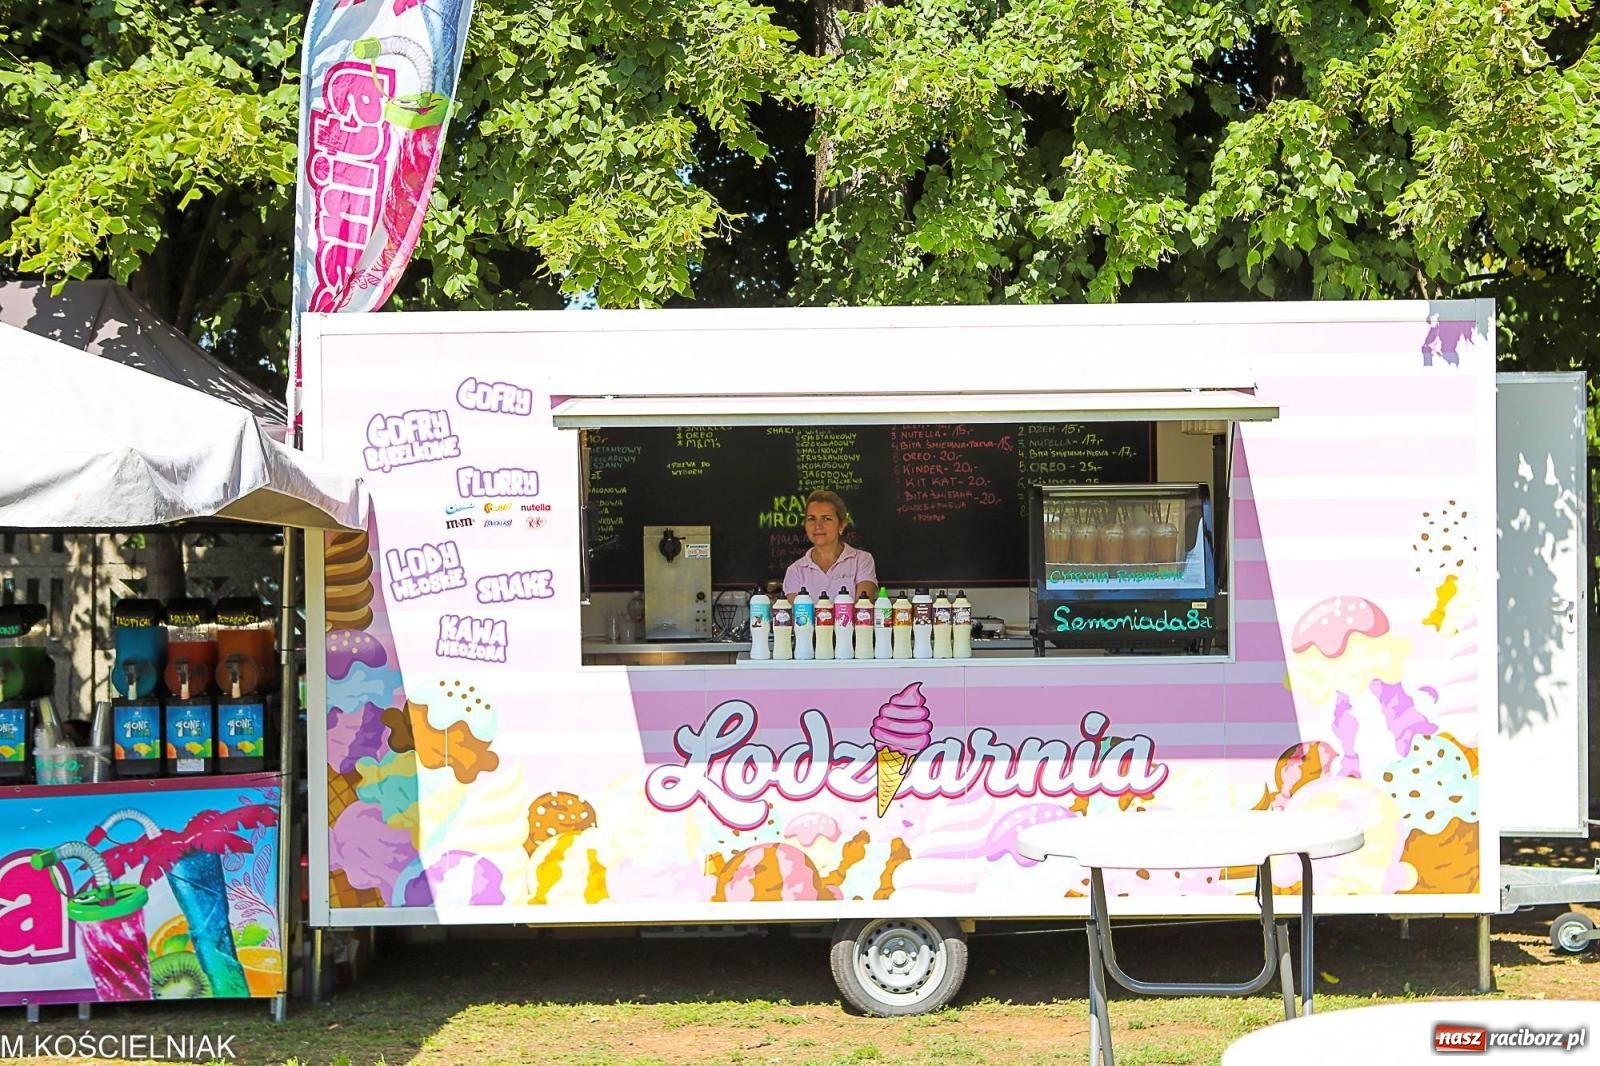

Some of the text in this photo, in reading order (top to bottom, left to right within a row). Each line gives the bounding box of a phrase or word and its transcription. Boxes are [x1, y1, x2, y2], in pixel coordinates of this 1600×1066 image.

[456, 377, 532, 416] GOFRY
[366, 409, 451, 448] GOFRY
[686, 431, 714, 440] OREO
[456, 466, 539, 498] FLURRY
[802, 470, 853, 480] JAGODOWY
[1029, 462, 1066, 473] OREO
[521, 504, 551, 512] nutella
[386, 541, 461, 582] LODY
[475, 569, 555, 604] SHAKE
[438, 614, 508, 647] KAWA
